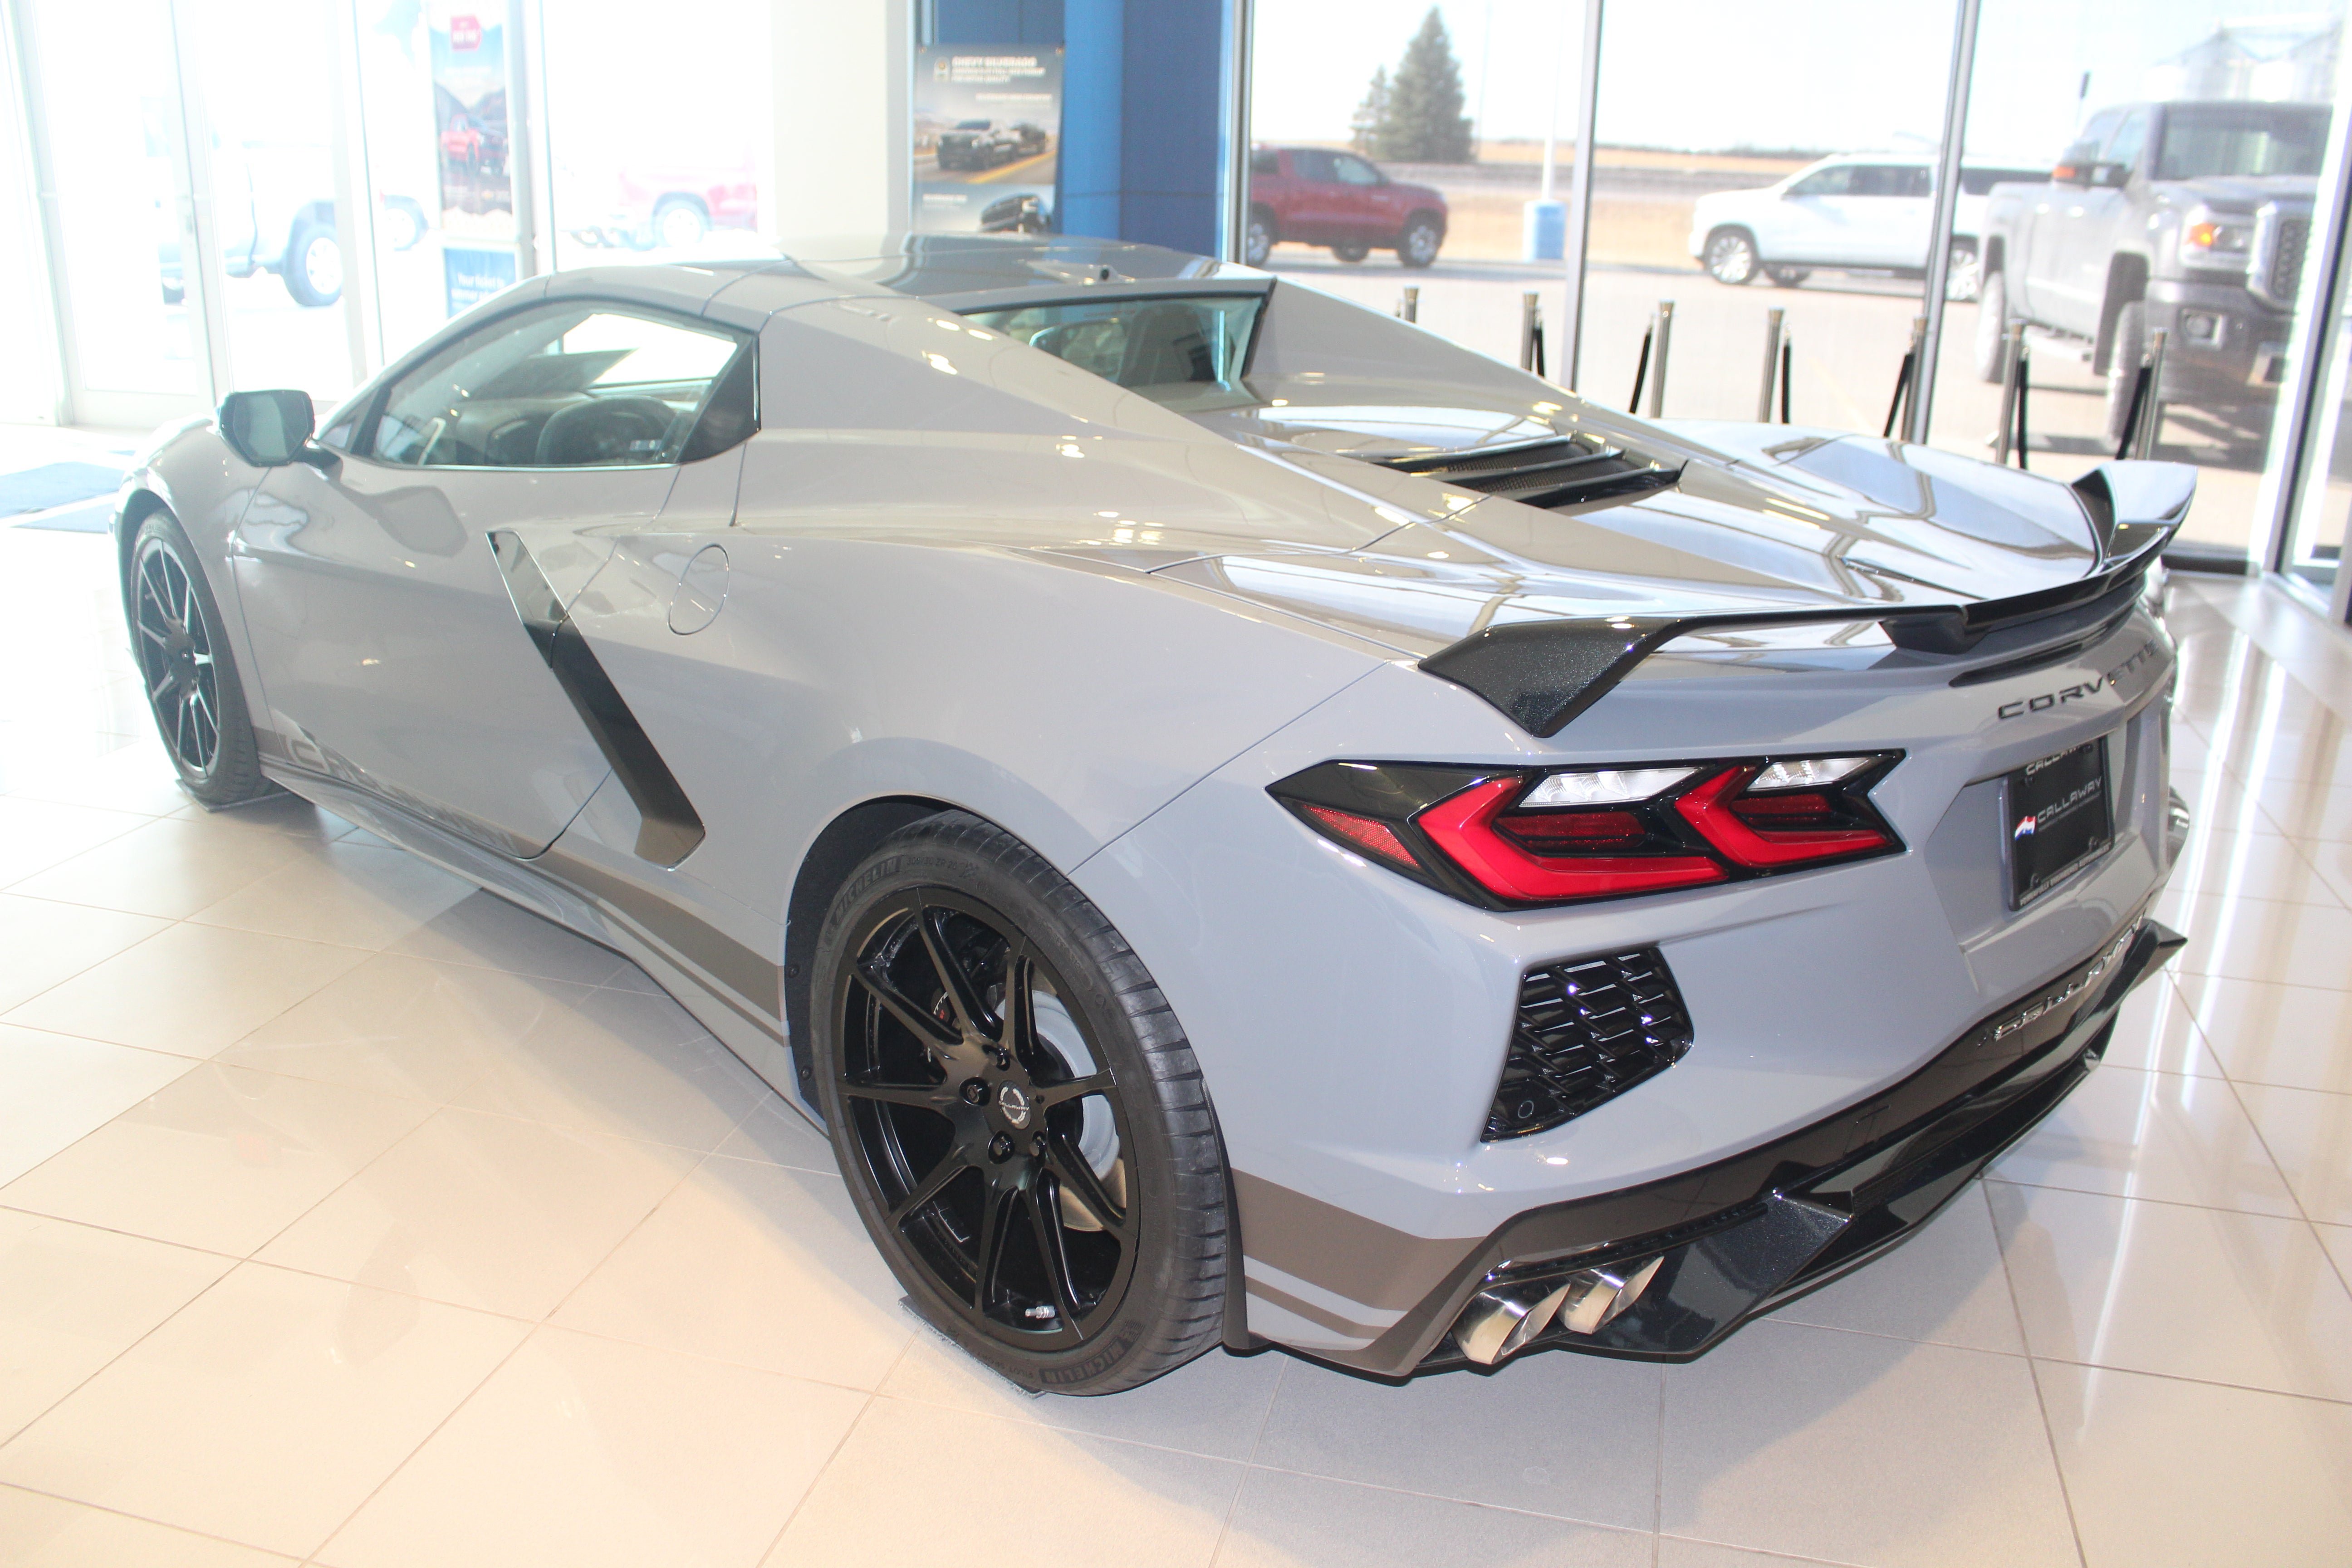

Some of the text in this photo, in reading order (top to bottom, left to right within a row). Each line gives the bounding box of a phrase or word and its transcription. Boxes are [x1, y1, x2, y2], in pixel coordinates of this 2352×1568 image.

[1998, 639, 2158, 719] CORVETTE
[2037, 776, 2102, 824] CALLAWAY
[834, 857, 897, 923] MICHELIN
[1044, 1339, 1125, 1383] MICHELIN
